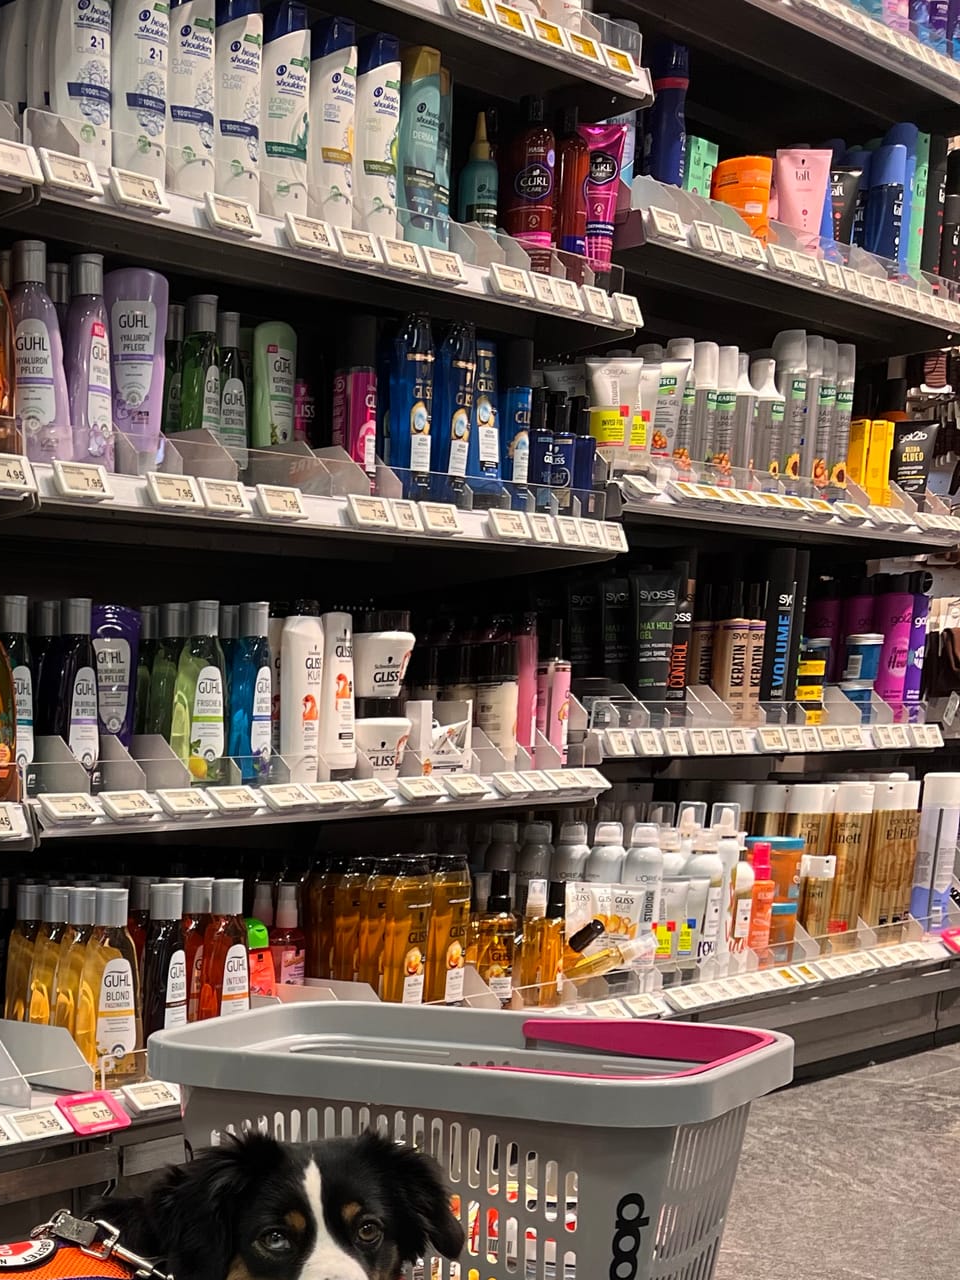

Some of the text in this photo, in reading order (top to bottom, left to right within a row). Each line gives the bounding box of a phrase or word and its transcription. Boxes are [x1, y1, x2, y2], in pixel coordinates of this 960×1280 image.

[180, 39, 212, 53] shoulders
[230, 55, 259, 69] shoulders
[276, 79, 306, 92] shoulders
[520, 176, 548, 187] CURL
[795, 170, 810, 182] taft
[119, 314, 149, 329] GUHL
[16, 336, 48, 351] GUHL
[898, 430, 928, 444] got2b
[6, 468, 25, 481] 4.95
[84, 476, 103, 488] 7.95
[640, 589, 675, 601] syoss
[656, 621, 673, 631] HOLD
[771, 614, 791, 688] VOLUME
[670, 640, 688, 688] CONTROL
[730, 644, 746, 688] KERATIN
[749, 645, 763, 688] KERATIN
[374, 671, 400, 683] GLISS
[198, 681, 221, 694] GUHL
[614, 896, 634, 905] GLISS
[644, 890, 655, 923] STUDIO
[104, 974, 131, 988] GUHL
[106, 990, 130, 1002] BLOND
[154, 1091, 173, 1101] 7.95
[92, 1108, 112, 1120] 0.75
[40, 1118, 60, 1130] 3.95
